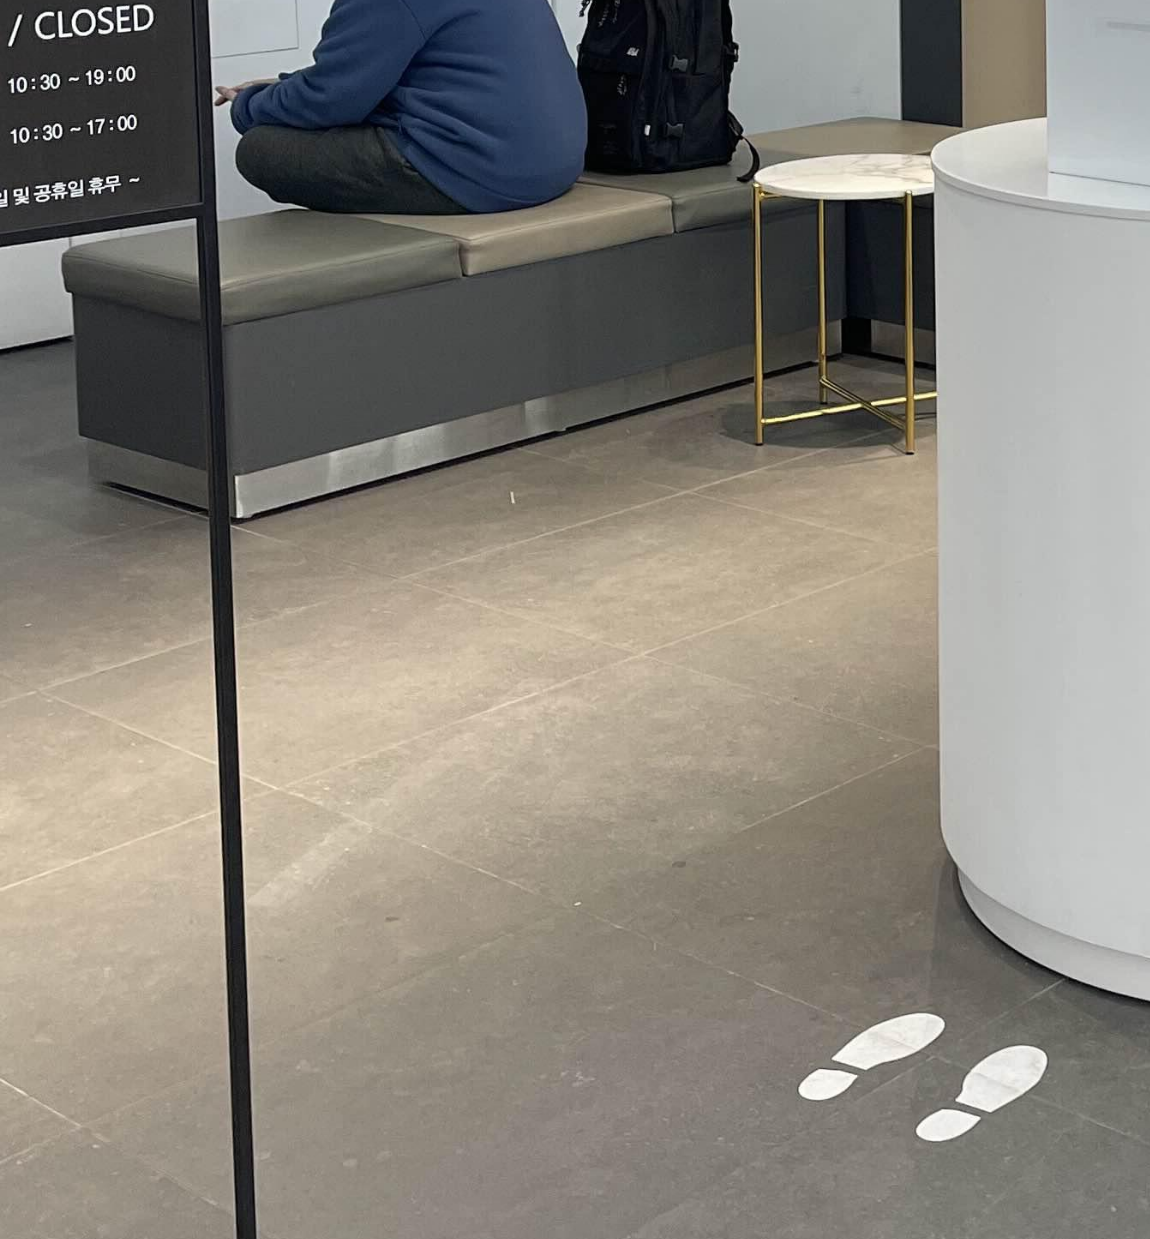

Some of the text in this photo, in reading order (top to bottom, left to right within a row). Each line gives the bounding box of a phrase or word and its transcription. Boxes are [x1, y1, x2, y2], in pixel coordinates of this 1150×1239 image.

[34, 4, 154, 40] CLOSED
[13, 186, 30, 205] 및
[33, 179, 85, 203] 공휴일
[88, 175, 122, 195] 휴무
